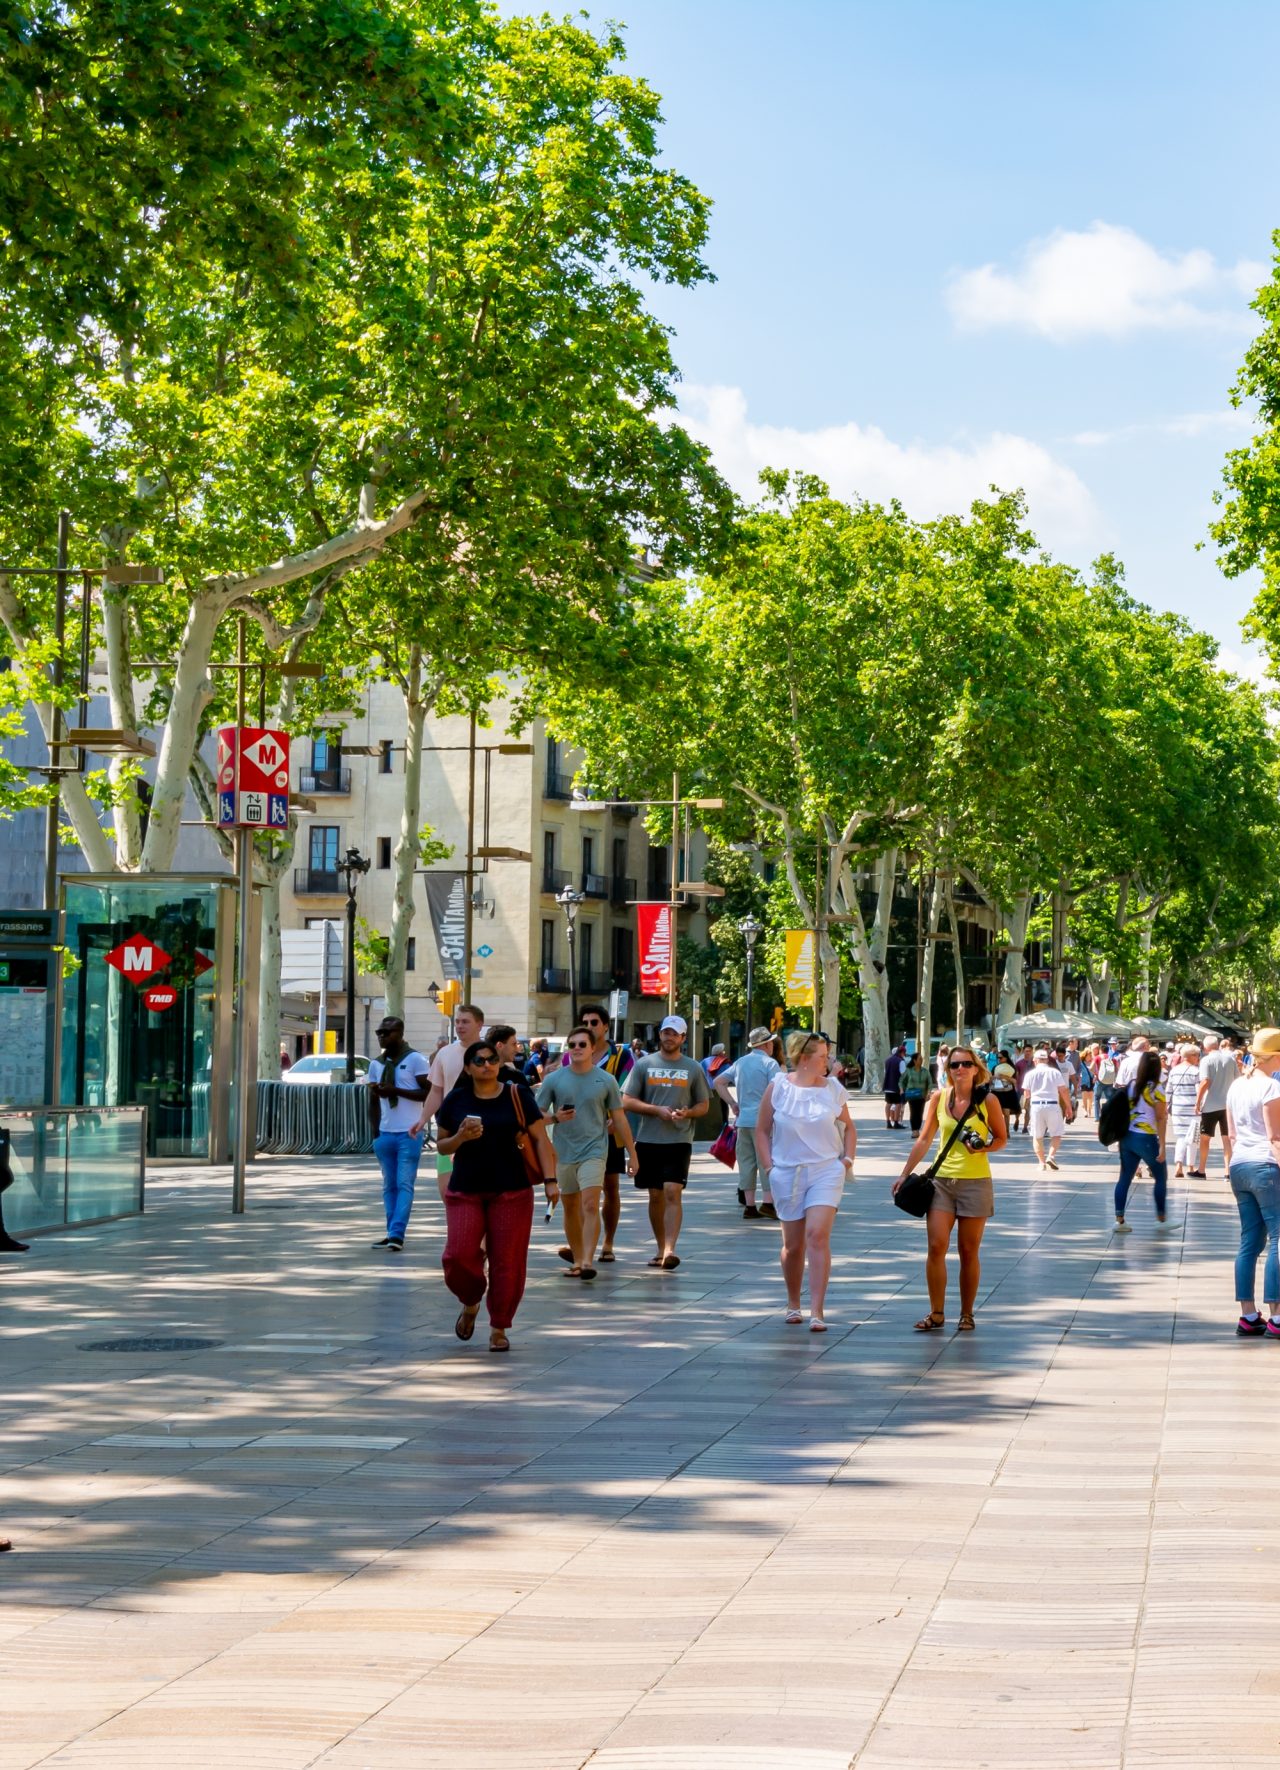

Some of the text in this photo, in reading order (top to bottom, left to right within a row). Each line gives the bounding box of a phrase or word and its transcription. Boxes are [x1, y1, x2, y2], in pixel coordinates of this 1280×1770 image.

[258, 744, 277, 765] M
[123, 946, 153, 971] M
[149, 995, 173, 1003] TMB
[647, 1067, 689, 1079] TEXAS
